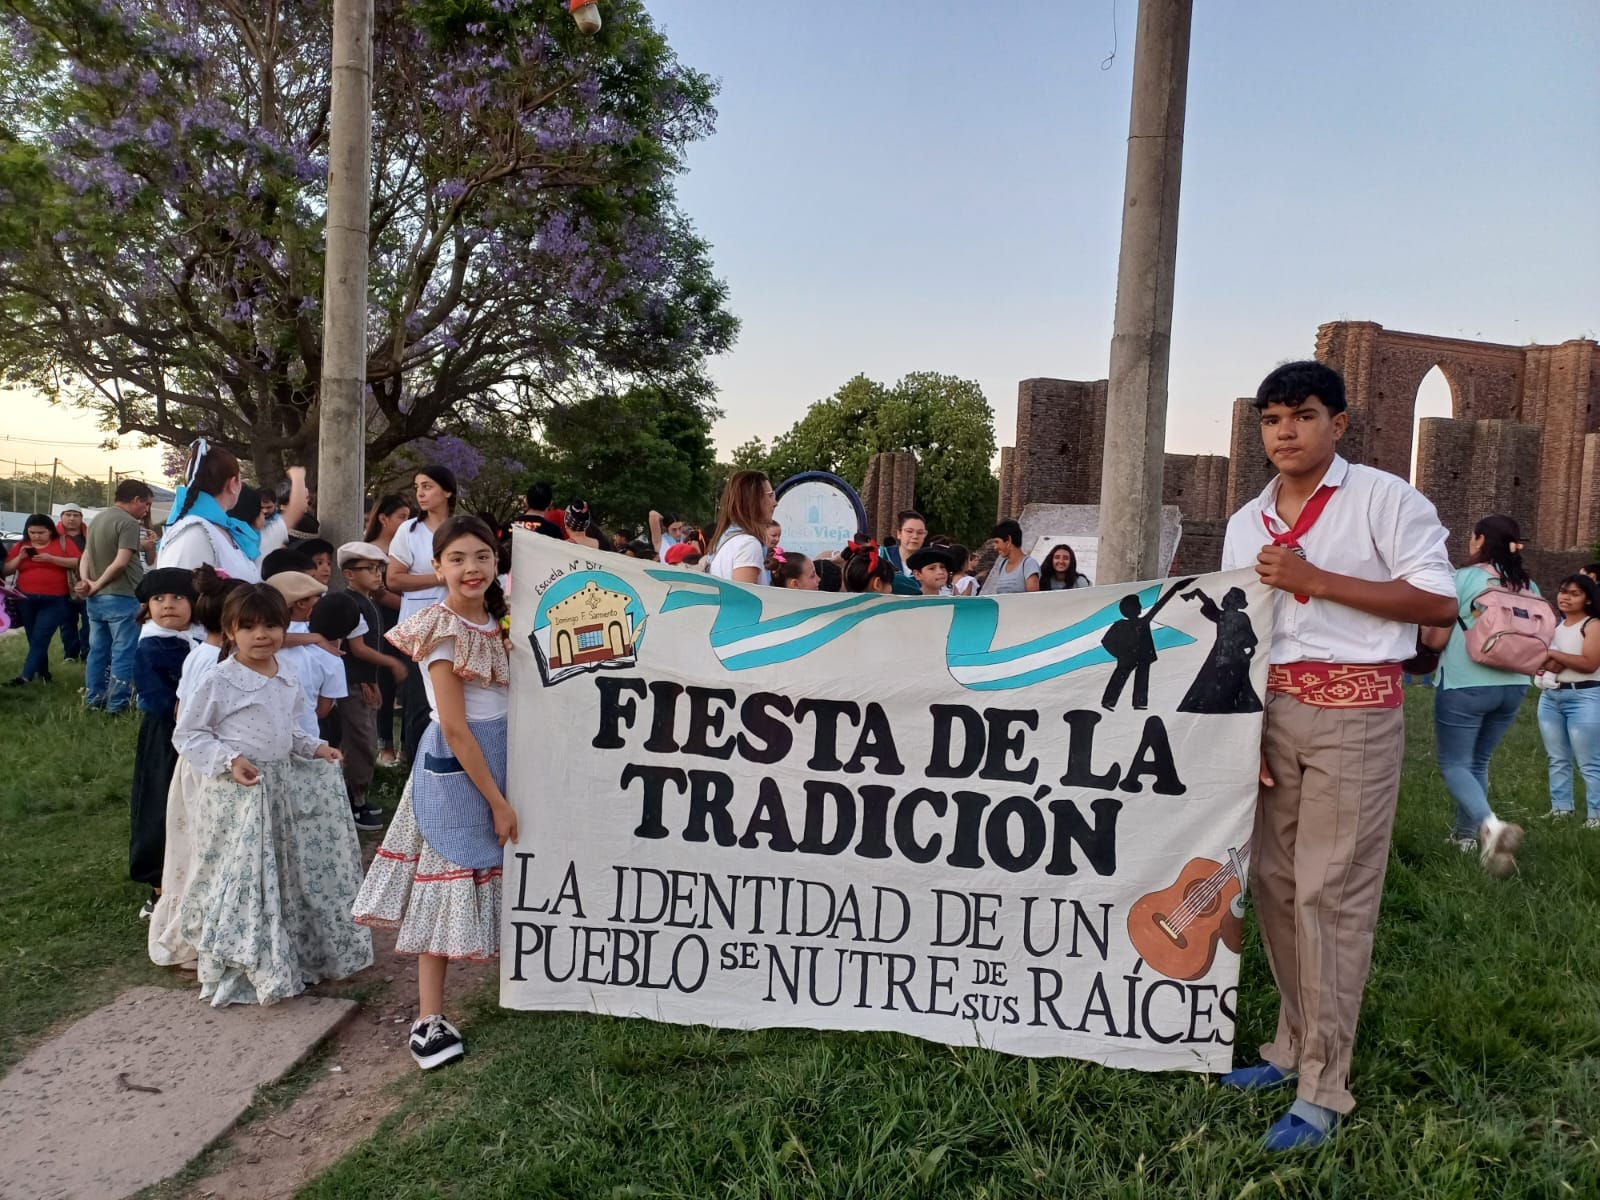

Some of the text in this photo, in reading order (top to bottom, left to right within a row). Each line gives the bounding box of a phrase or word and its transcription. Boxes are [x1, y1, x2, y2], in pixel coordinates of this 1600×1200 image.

[534, 568, 565, 596] Escuela
[814, 526, 851, 541] Vieja
[554, 615, 579, 626] Domingo
[588, 608, 618, 620] Sarmiento
[592, 676, 1186, 795] FIESTA DE LA
[620, 763, 1123, 876] TRADICIÓN
[512, 852, 1114, 961] LA IDENTIDAD DE UN
[510, 922, 1239, 1046] PUEBLO SE NUTRE DE SUS RAÍCES
